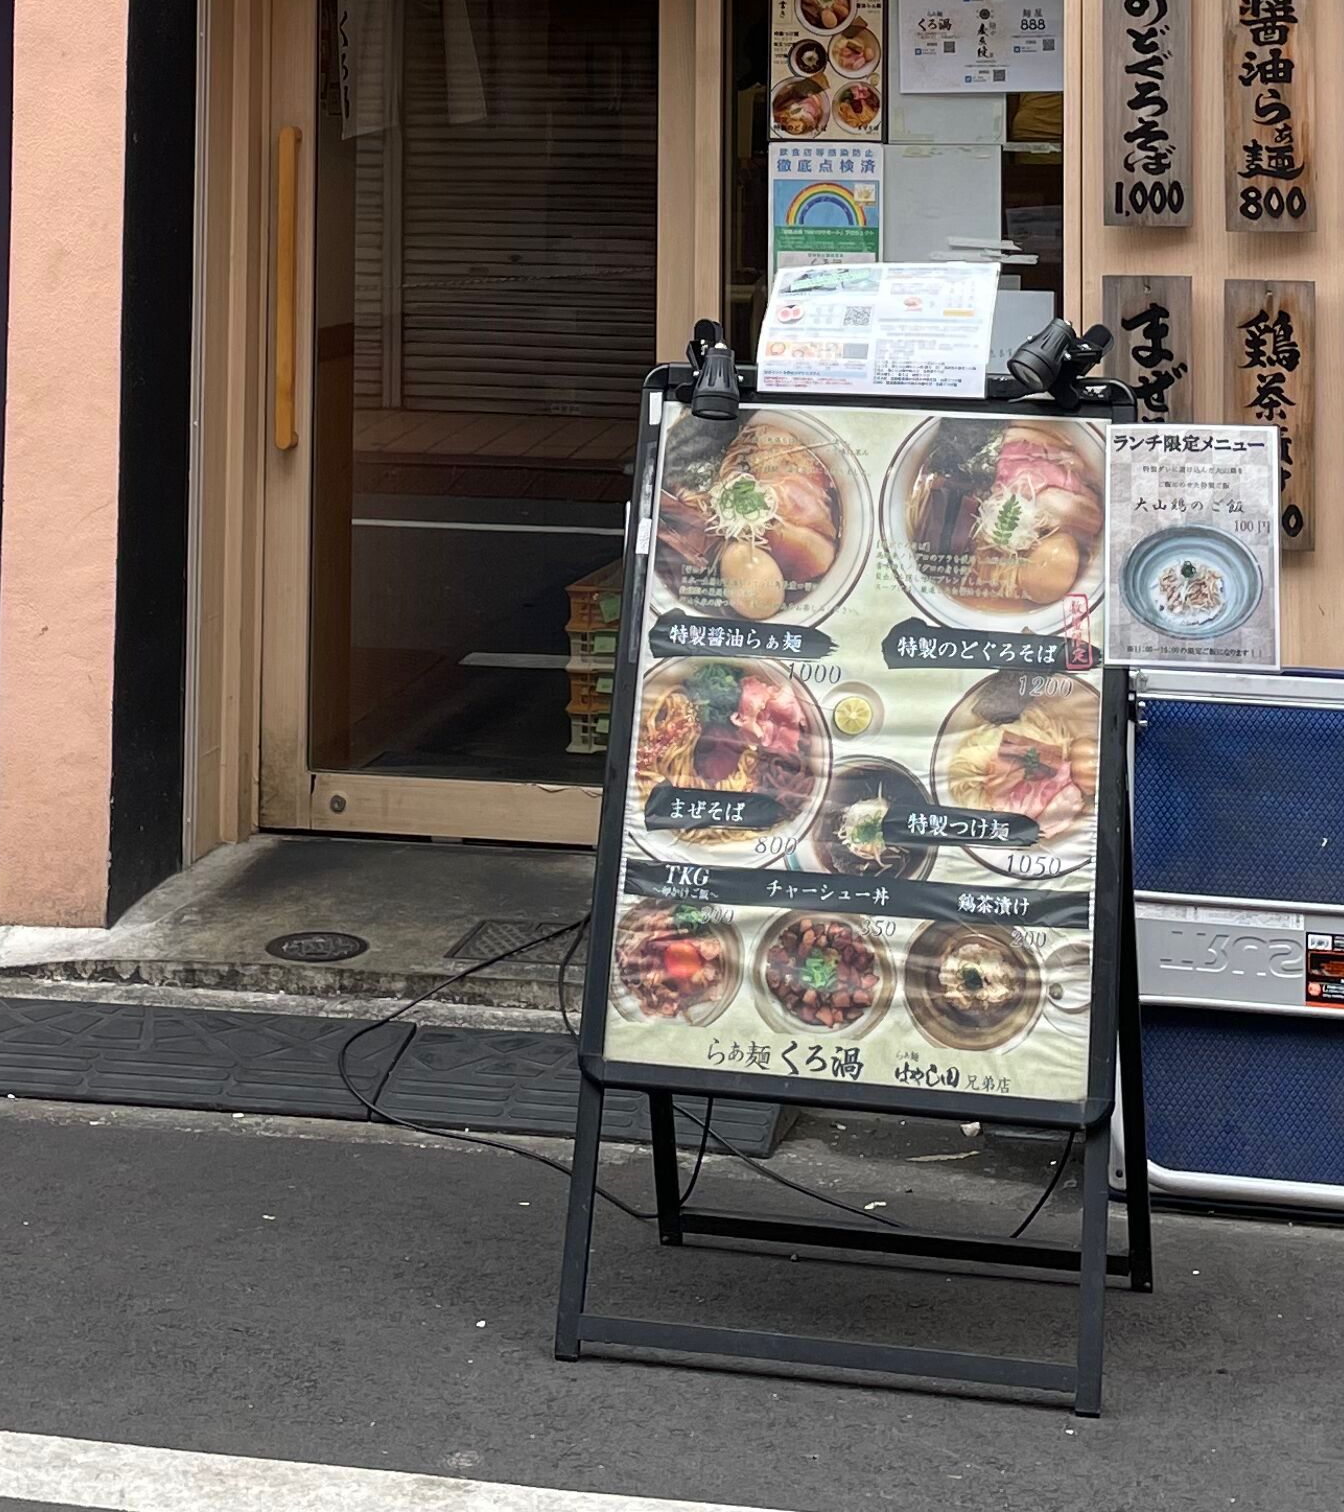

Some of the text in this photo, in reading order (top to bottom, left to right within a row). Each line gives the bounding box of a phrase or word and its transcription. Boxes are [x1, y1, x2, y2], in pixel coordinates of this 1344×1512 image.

[1020, 18, 1046, 31] 888
[776, 159, 876, 173] 徹底点検済
[1238, 186, 1307, 221] 800
[1120, 302, 1189, 424] まぜ
[1113, 434, 1266, 454] ランチ限定メニュー
[1233, 519, 1272, 534] 100円
[669, 624, 804, 653] 特製醤油らぁ麺
[787, 660, 843, 685] 1000
[1018, 674, 1074, 700] 1200
[669, 798, 746, 823] まぜそば
[906, 812, 1012, 843] 特製つけ麺
[754, 835, 799, 857] 800
[663, 864, 711, 888] TKG
[1005, 852, 1063, 879] 1050
[766, 879, 891, 907] チャーシュー丼
[956, 893, 1031, 917] 鶏茶漬け
[705, 1037, 865, 1081] らぁ麺 くろ渦
[964, 1073, 1012, 1094] 兄弟店
